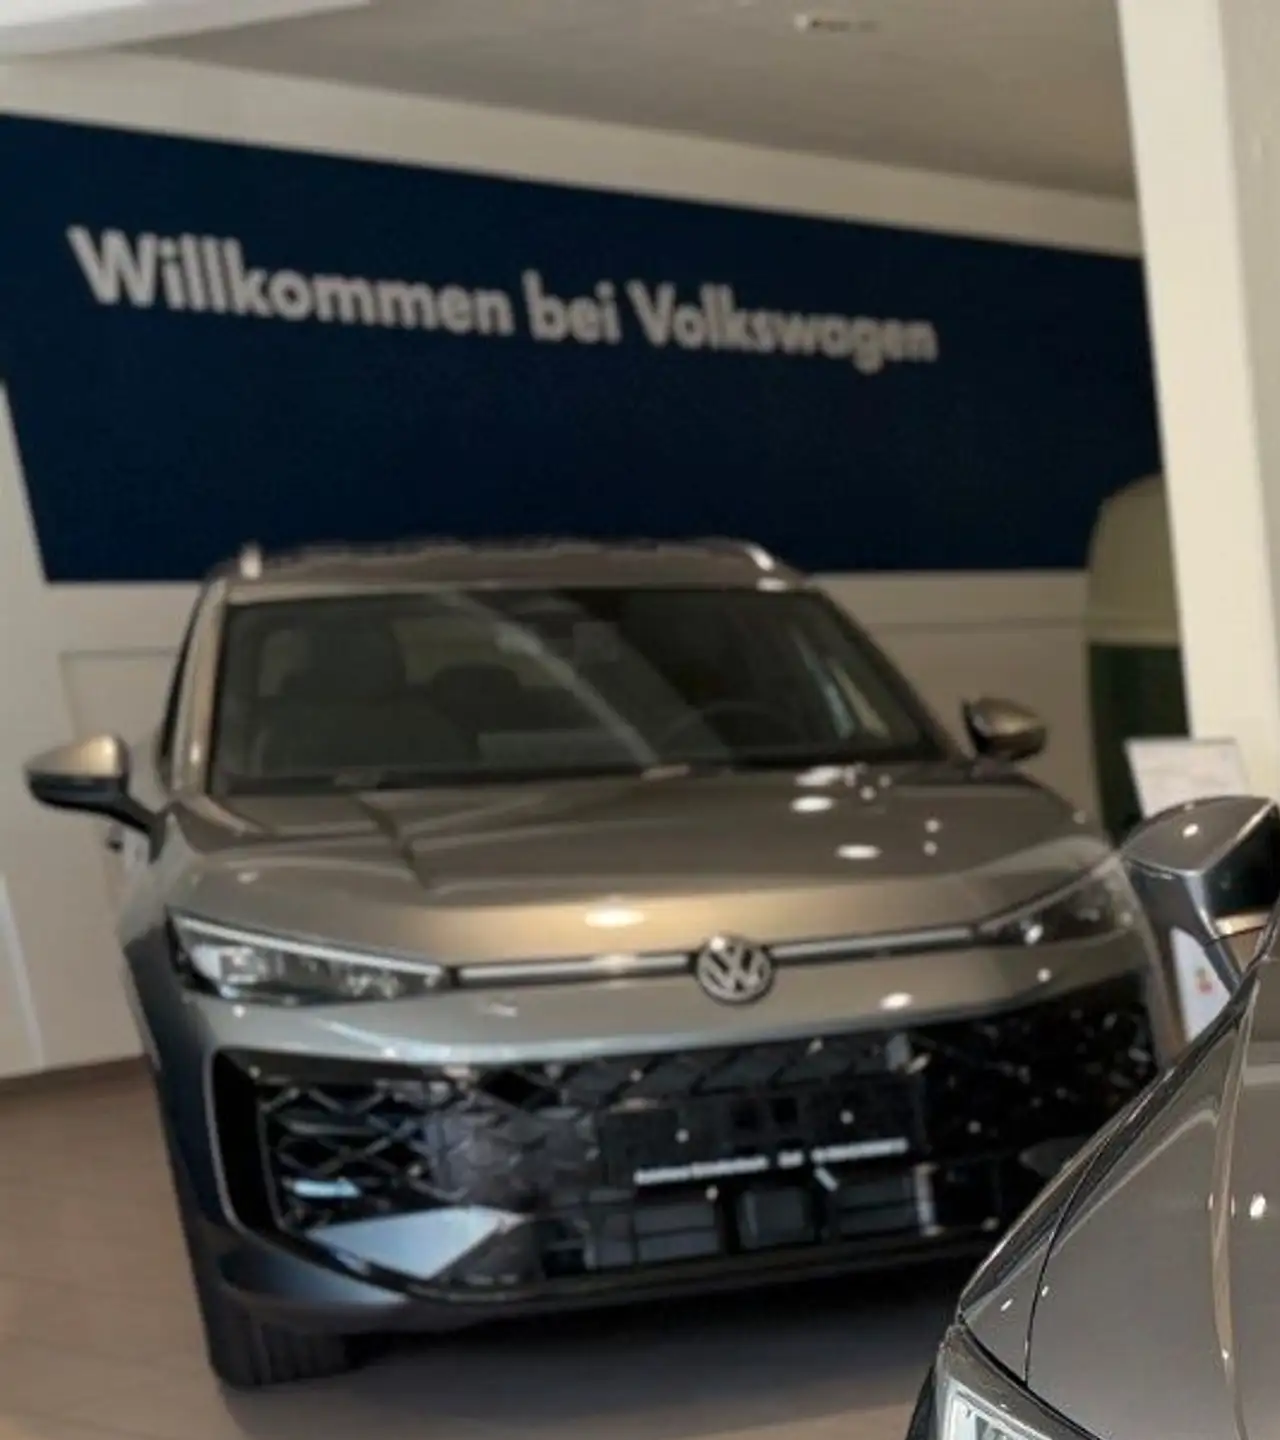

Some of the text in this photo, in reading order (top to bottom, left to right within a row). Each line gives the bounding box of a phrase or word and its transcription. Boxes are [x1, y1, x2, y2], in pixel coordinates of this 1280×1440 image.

[65, 224, 941, 376] Willkommen bei Volkswagen
